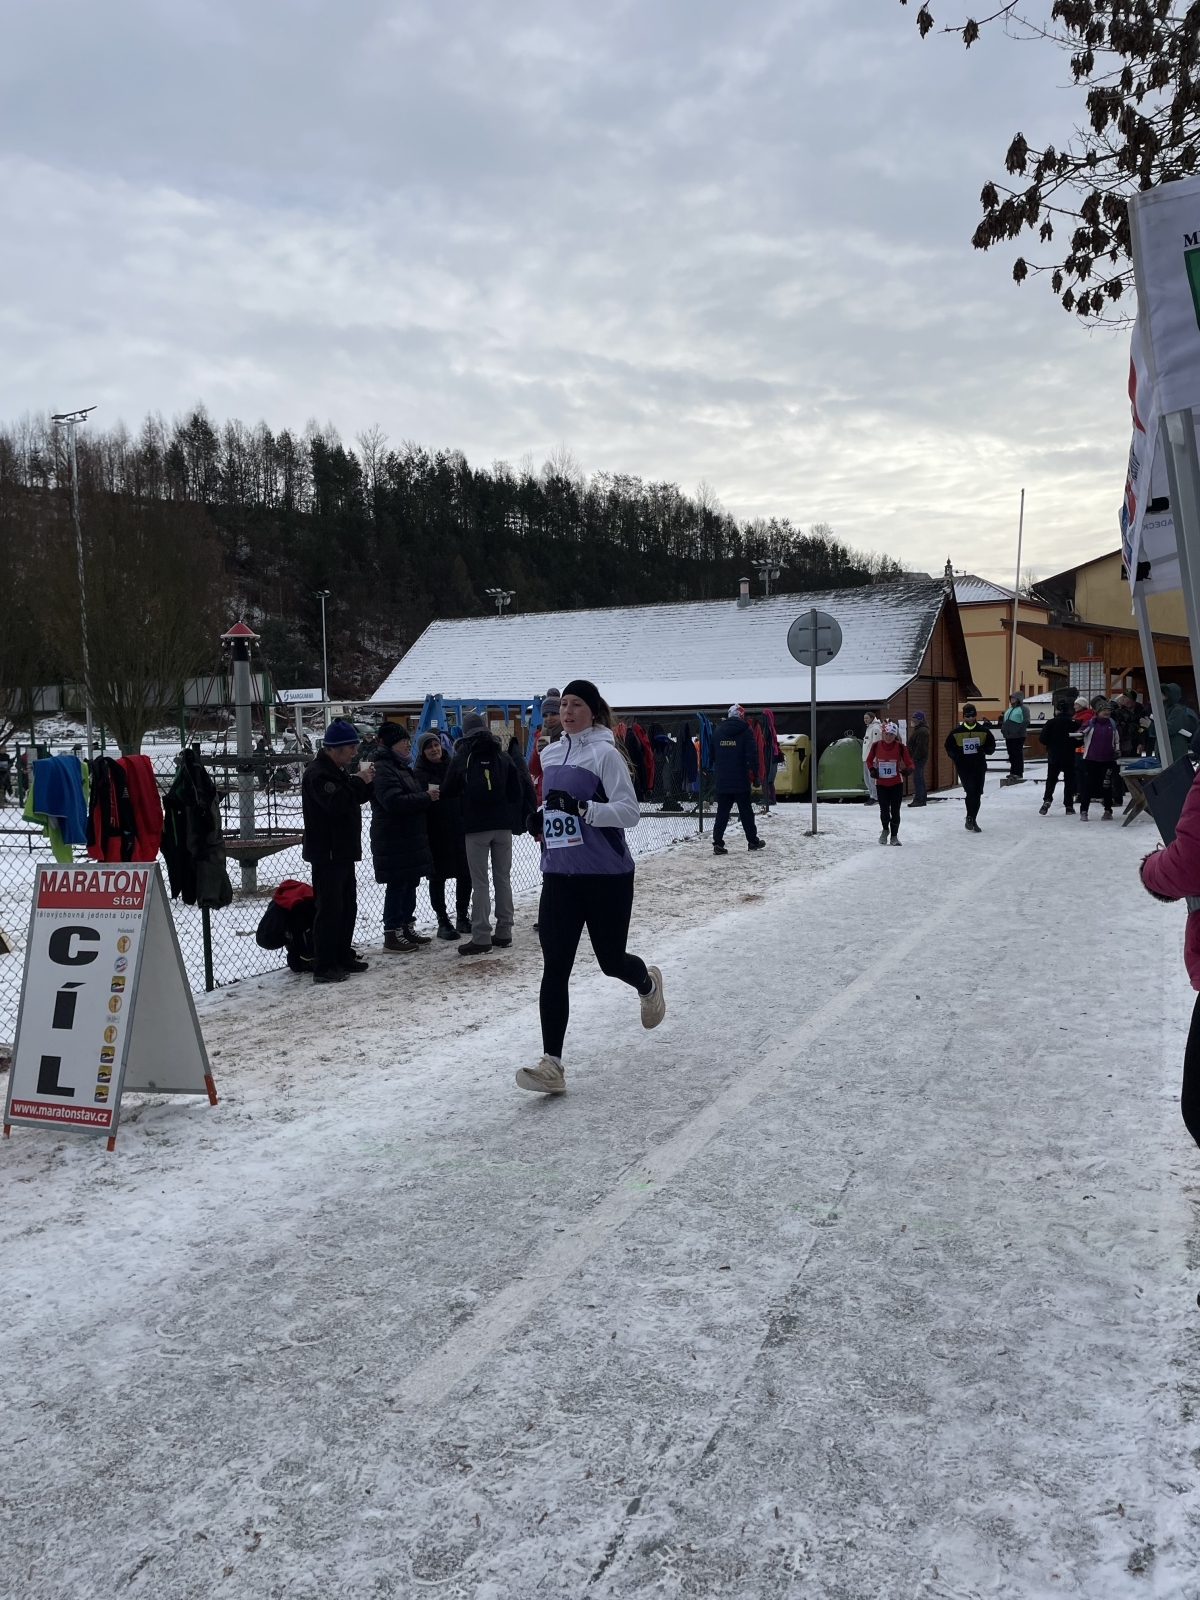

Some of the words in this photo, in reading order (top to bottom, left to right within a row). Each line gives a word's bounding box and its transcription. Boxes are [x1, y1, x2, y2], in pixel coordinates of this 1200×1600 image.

[1183, 230, 1200, 247] M
[545, 816, 577, 838] 298
[39, 870, 148, 893] MARATON
[112, 895, 141, 906] stav
[87, 911, 117, 920] jednota
[120, 911, 142, 920] Úpice
[14, 1103, 108, 1122] www.maratonstav.cz
